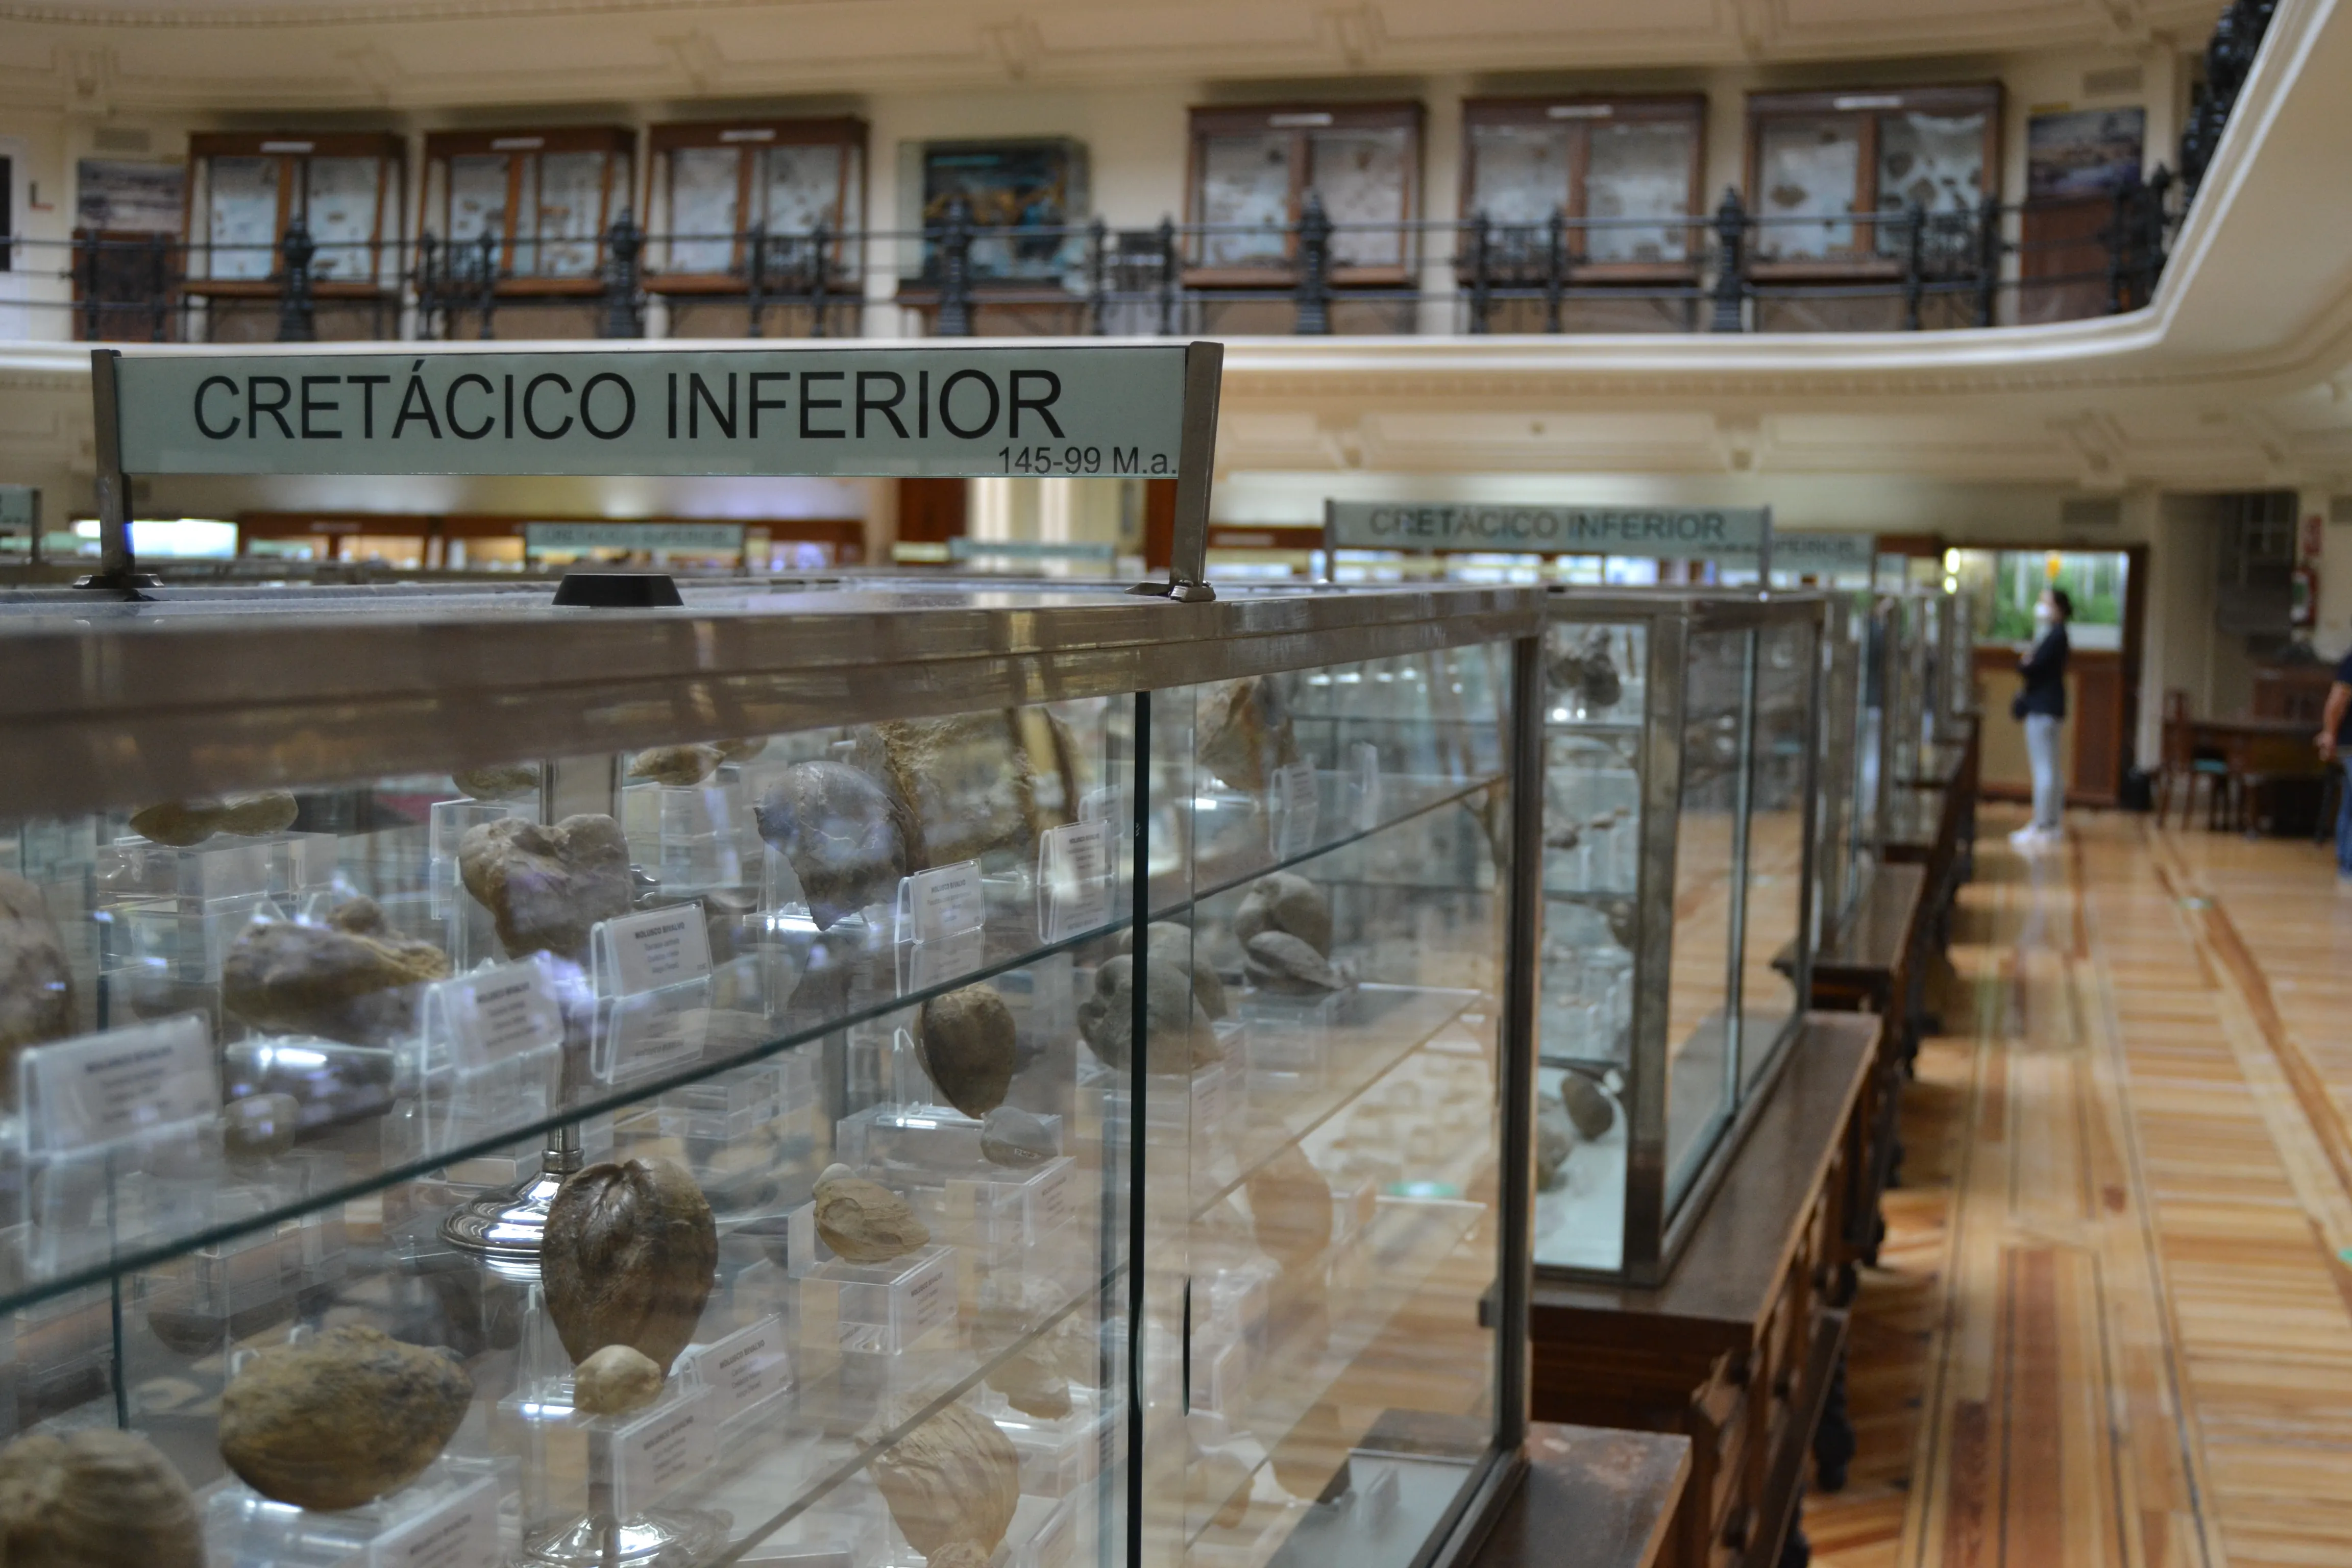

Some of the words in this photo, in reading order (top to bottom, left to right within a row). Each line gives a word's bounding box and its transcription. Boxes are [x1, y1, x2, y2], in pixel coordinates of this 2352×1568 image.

[193, 359, 636, 440] CRETÁCICO
[668, 369, 1067, 440] INFERIOR
[998, 446, 1101, 475] 145-99
[1112, 446, 1177, 475] M.a.
[1567, 510, 1727, 541] INFERIOR
